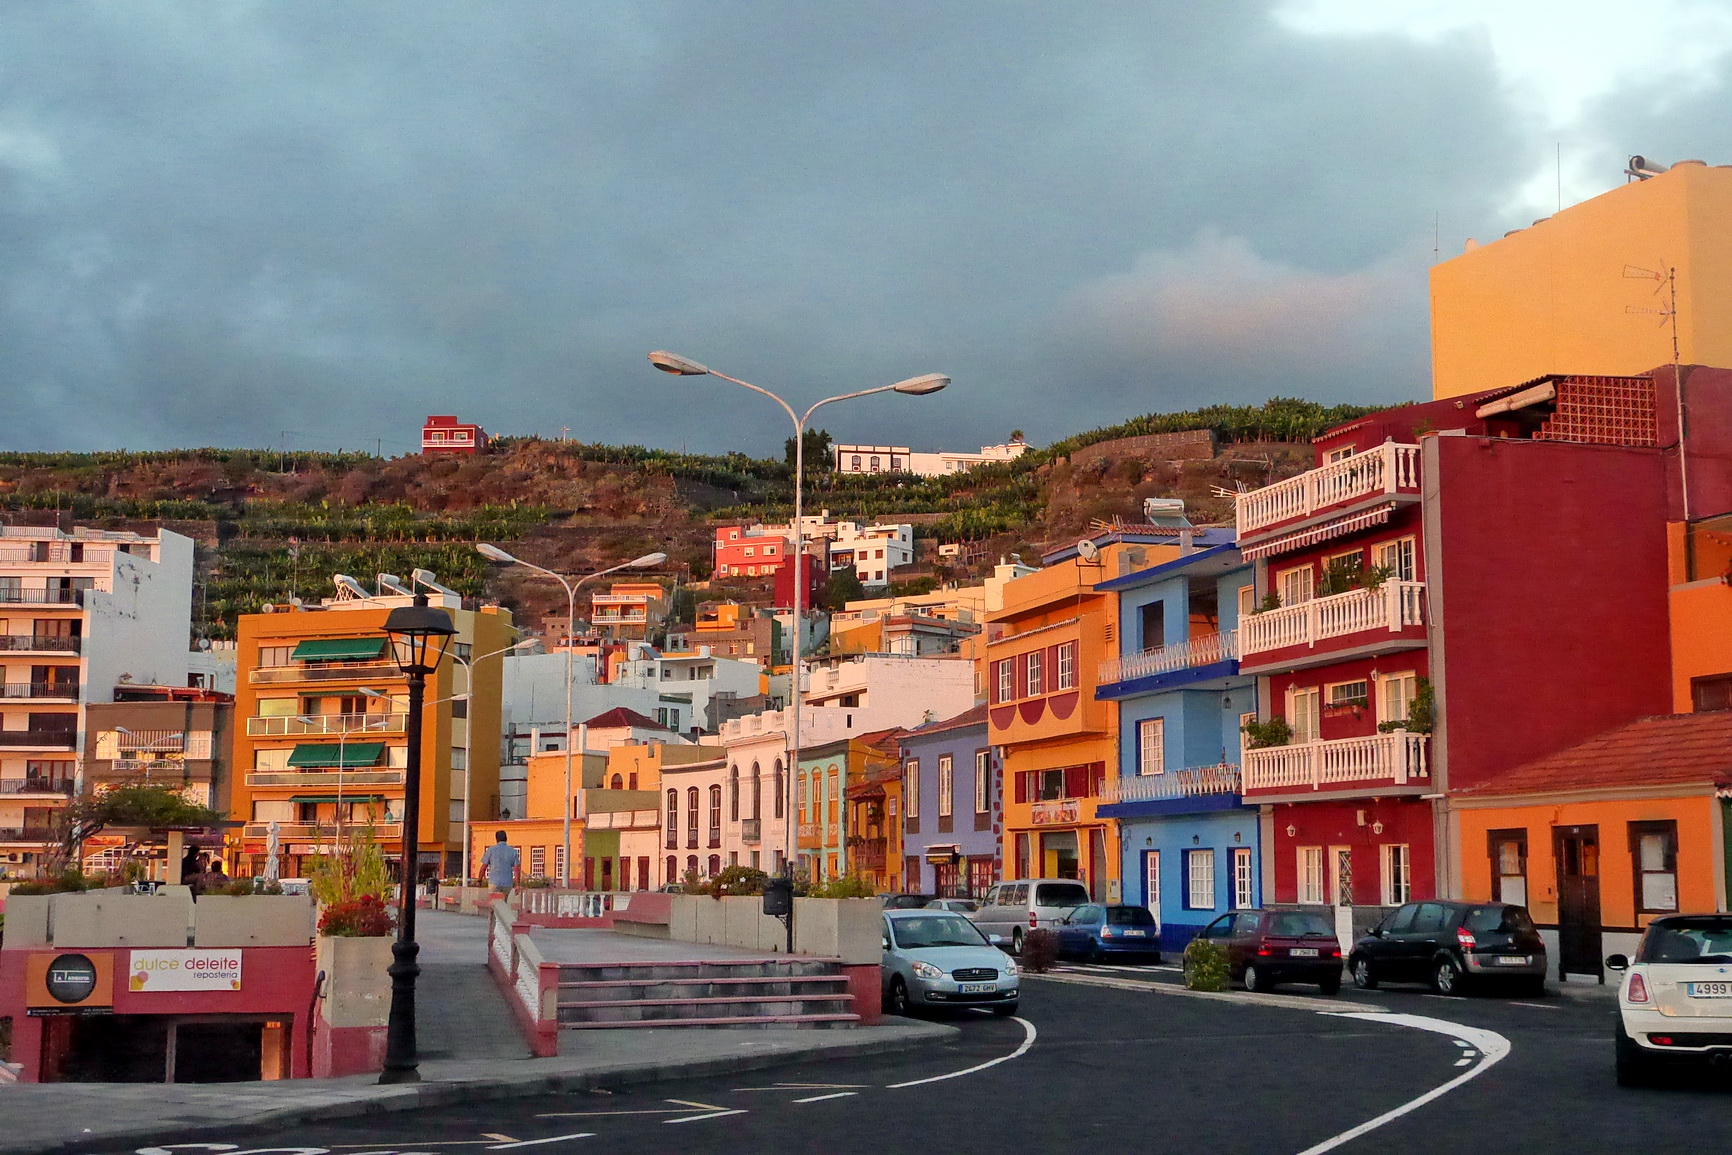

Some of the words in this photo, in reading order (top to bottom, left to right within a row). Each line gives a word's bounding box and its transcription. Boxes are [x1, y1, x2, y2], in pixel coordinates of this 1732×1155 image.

[134, 958, 179, 970] dulce
[184, 957, 238, 970] deleite
[193, 971, 238, 979] reposteria
[1696, 984, 1727, 994] 4999
